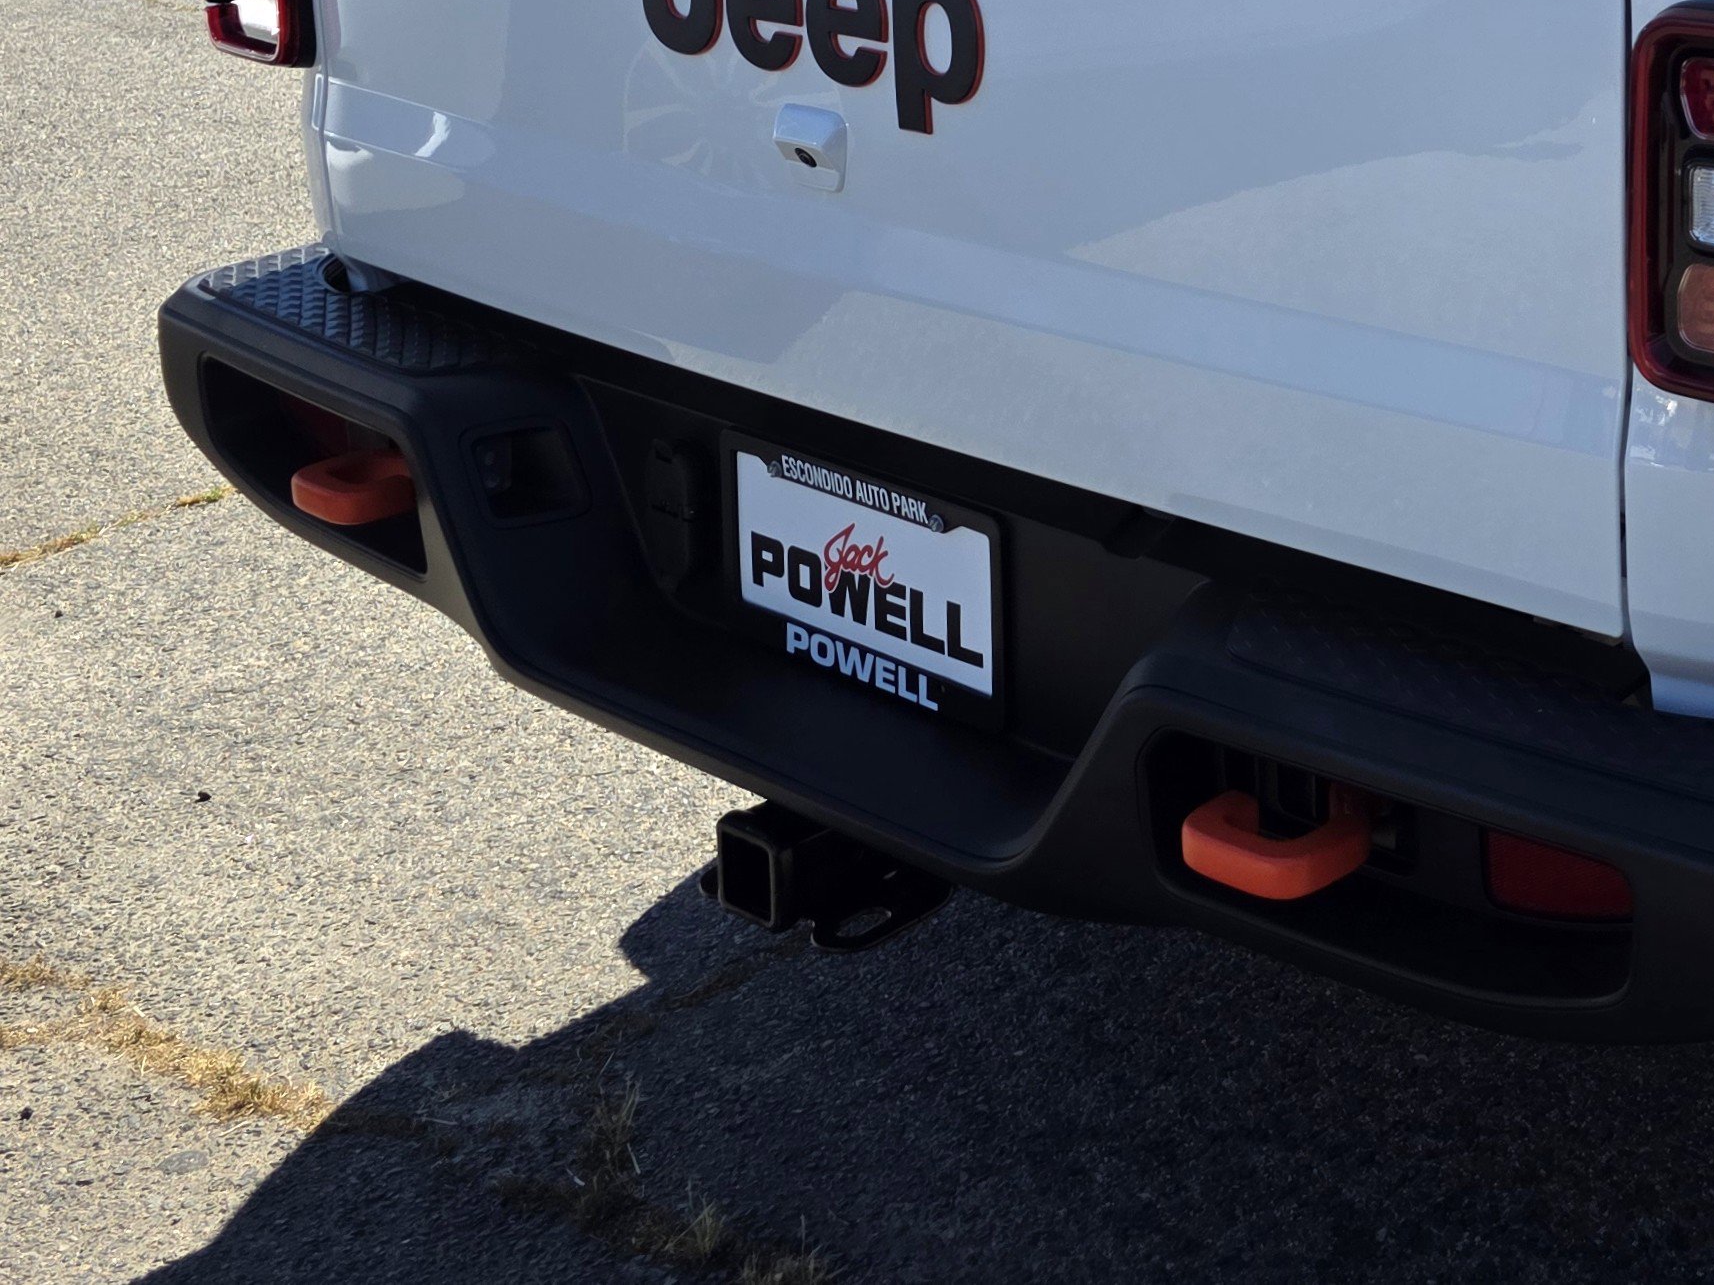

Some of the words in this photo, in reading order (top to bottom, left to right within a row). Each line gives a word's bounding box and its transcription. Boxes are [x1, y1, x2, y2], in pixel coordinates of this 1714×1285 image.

[780, 454, 853, 499] ESCONDIDO
[855, 480, 890, 512] AUTO
[890, 491, 929, 525] PARK
[823, 523, 895, 592] Jack
[750, 530, 984, 669] POWELL
[786, 622, 938, 711] POWELL
